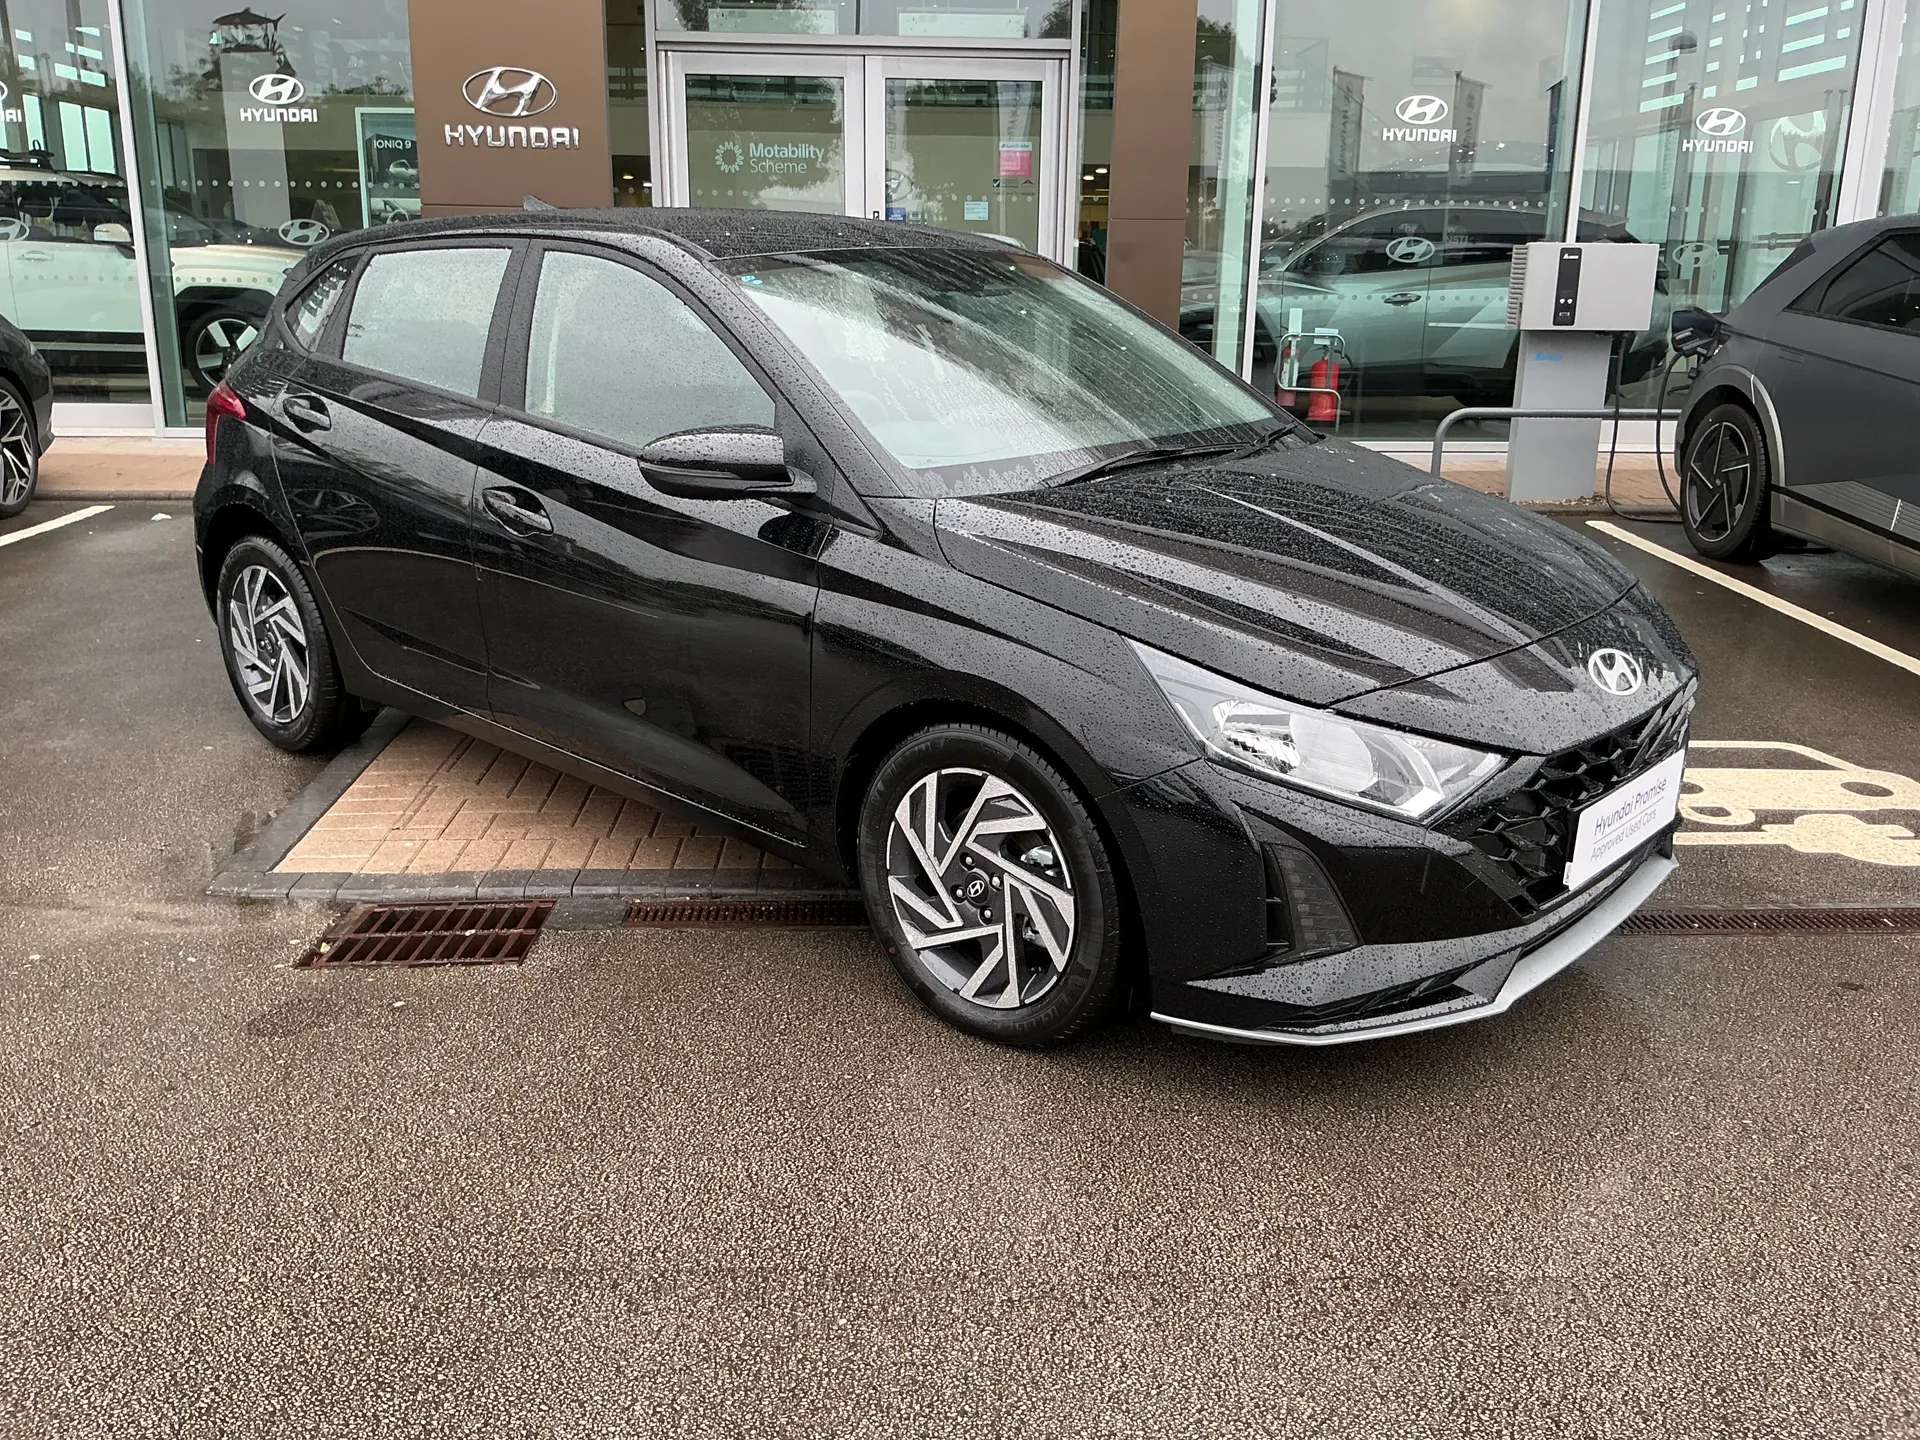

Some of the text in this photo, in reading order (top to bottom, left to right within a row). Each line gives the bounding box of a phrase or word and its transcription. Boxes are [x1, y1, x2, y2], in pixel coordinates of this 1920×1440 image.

[240, 108, 318, 123] HYUNDAI
[444, 124, 579, 149] HYUNDAI
[1382, 127, 1457, 143] HYUNDAI
[374, 139, 412, 150] IONIQ 9
[749, 142, 825, 162] Motability
[1682, 139, 1754, 153] HYUNDAI
[750, 158, 808, 174] Scheme
[1594, 778, 1667, 836] Hyundai Promise
[1591, 808, 1657, 862] Approved Used Cars
